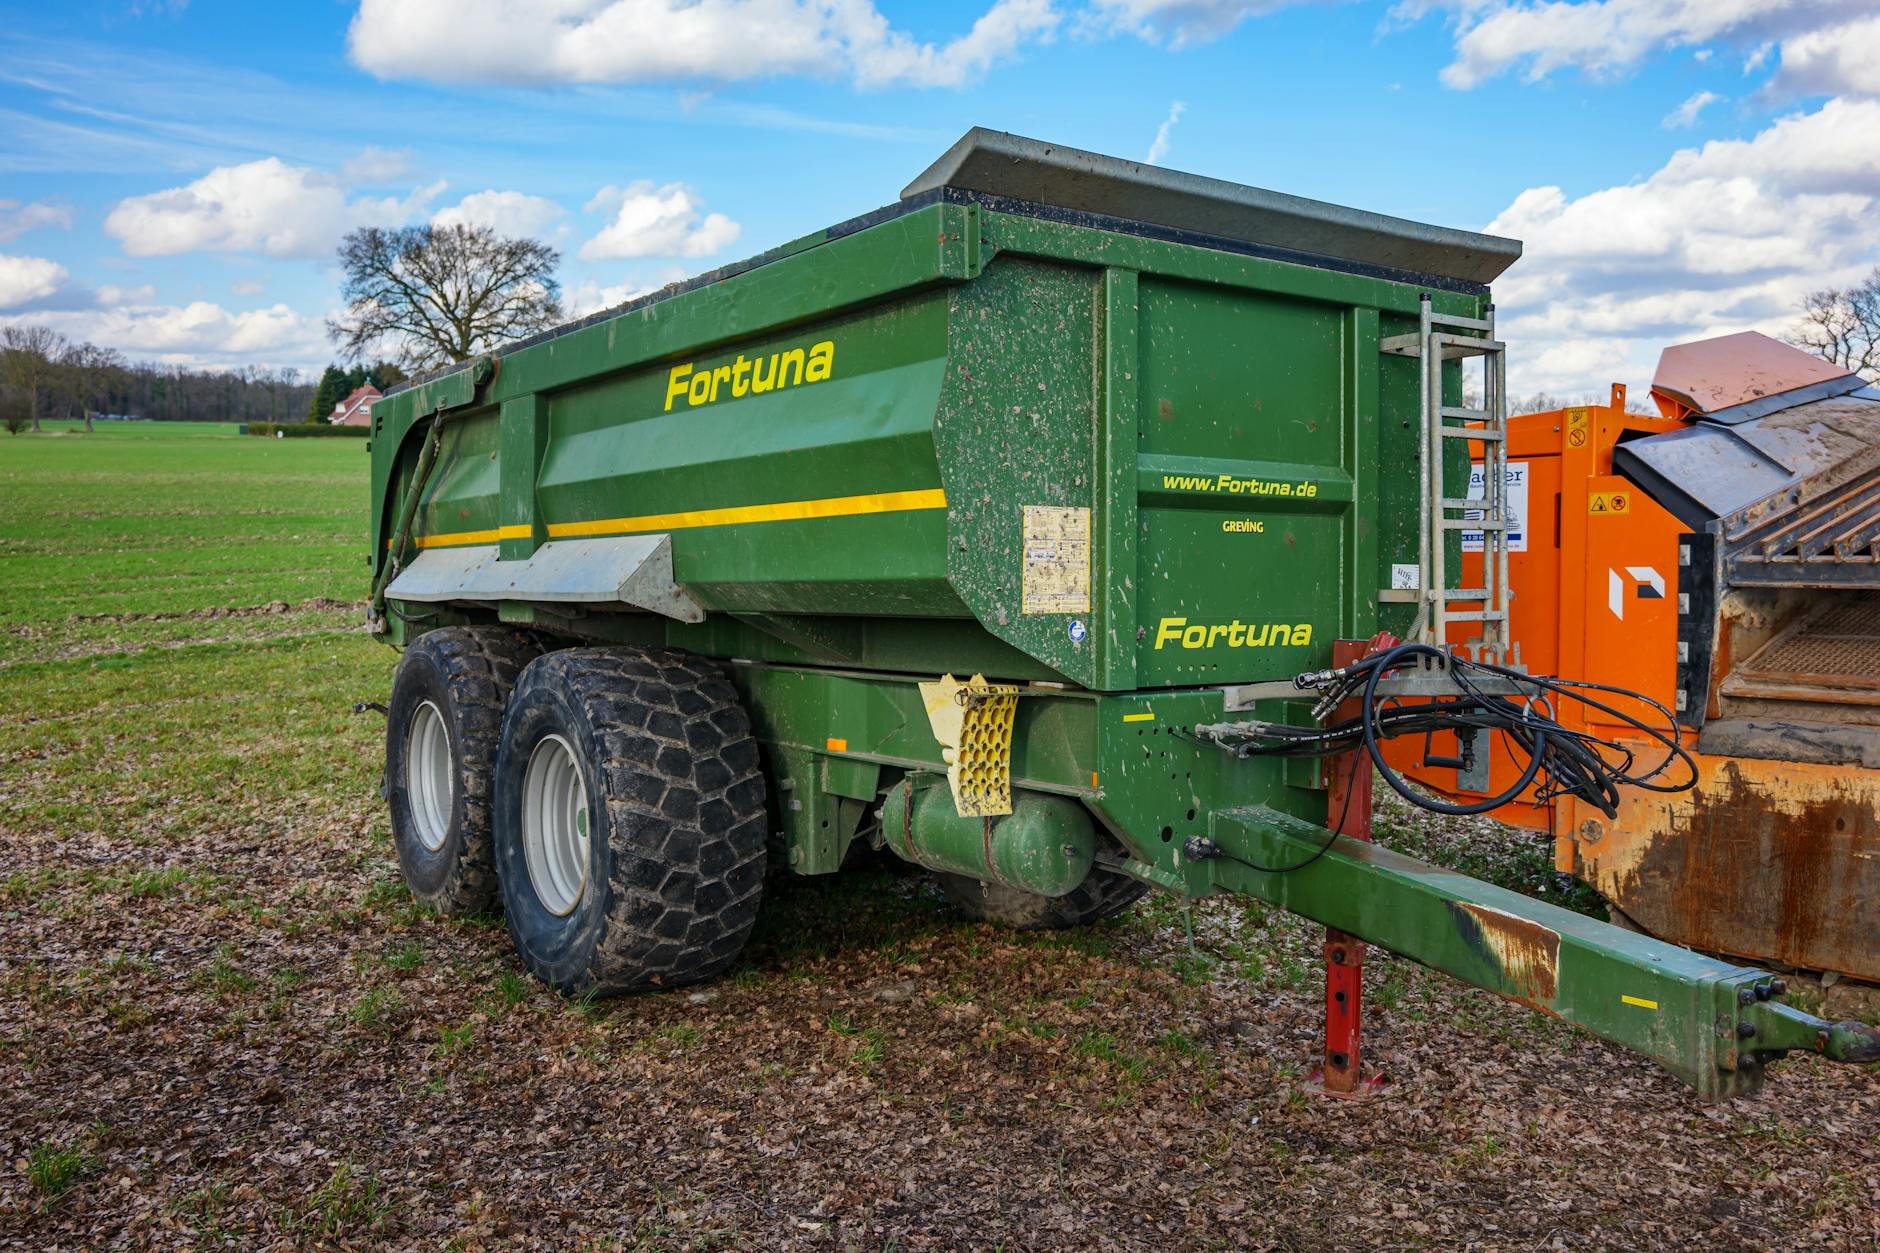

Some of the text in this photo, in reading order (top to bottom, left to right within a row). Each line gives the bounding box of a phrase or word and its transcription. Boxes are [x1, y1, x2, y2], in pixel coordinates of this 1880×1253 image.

[664, 340, 835, 411] Fortuna
[1163, 475, 1318, 498] www.Fortuna.de
[1155, 617, 1313, 650] Fortuna
